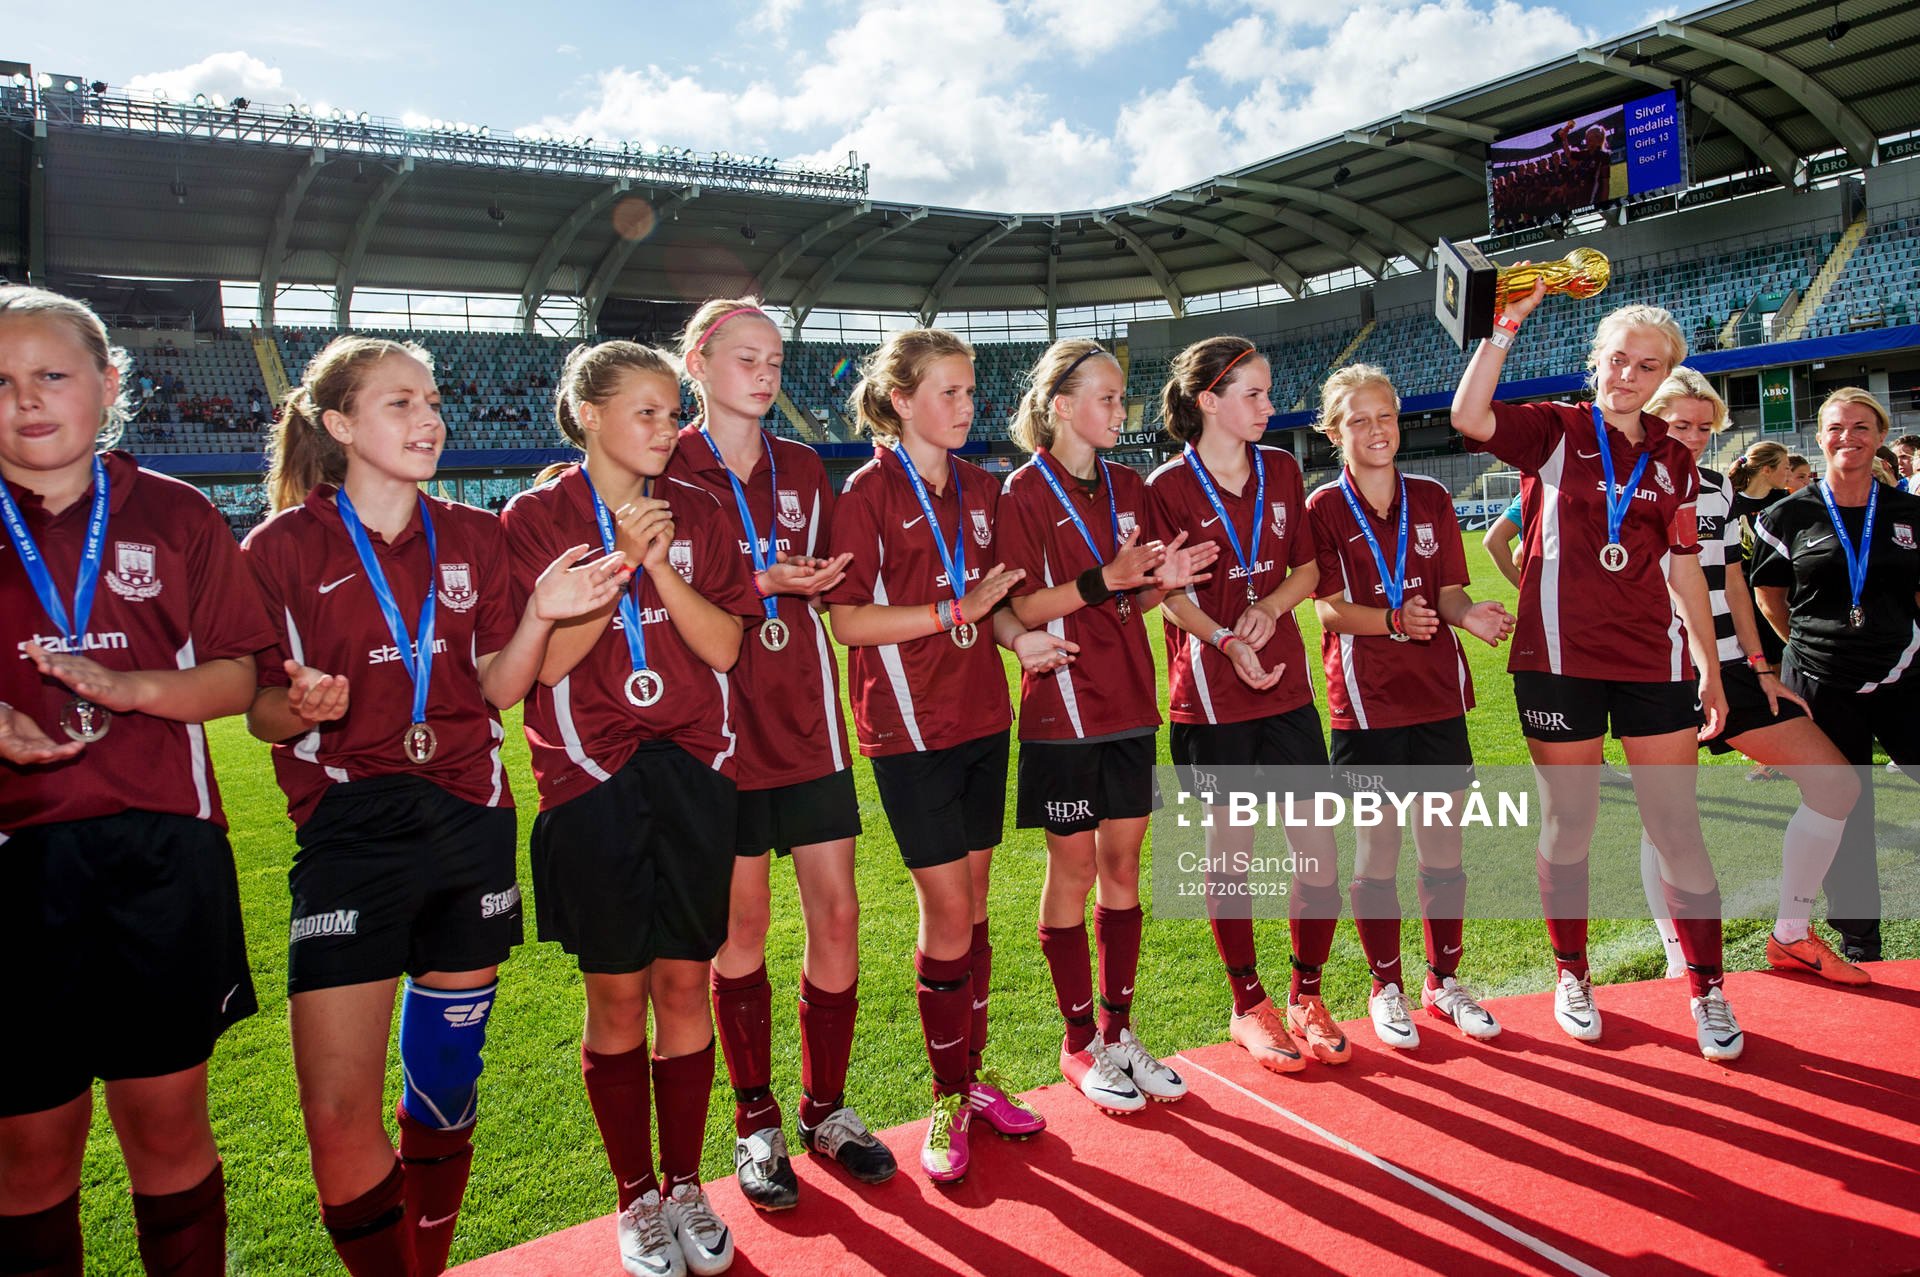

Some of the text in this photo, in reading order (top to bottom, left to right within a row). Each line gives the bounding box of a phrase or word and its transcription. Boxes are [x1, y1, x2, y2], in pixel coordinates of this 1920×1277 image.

[1635, 104, 1666, 119] Silver
[1629, 115, 1674, 136] medalist
[1635, 132, 1669, 149] Girls 13
[1639, 150, 1668, 165] Boo FF
[1483, 242, 1501, 253] BRO
[1596, 480, 1658, 502] saum
[95, 496, 105, 520] YOUTH
[1455, 505, 1470, 515] KF
[2, 498, 37, 561] YOUTH CUP 2012
[92, 521, 101, 536] CUP
[604, 527, 613, 540] CUP
[86, 537, 98, 560] 2012
[612, 607, 670, 630] sdium
[368, 638, 448, 664] stadm
[1523, 709, 1573, 731] HDR
[1190, 763, 1222, 795] DR
[1341, 770, 1391, 793] HDR
[1044, 799, 1094, 818] HDR
